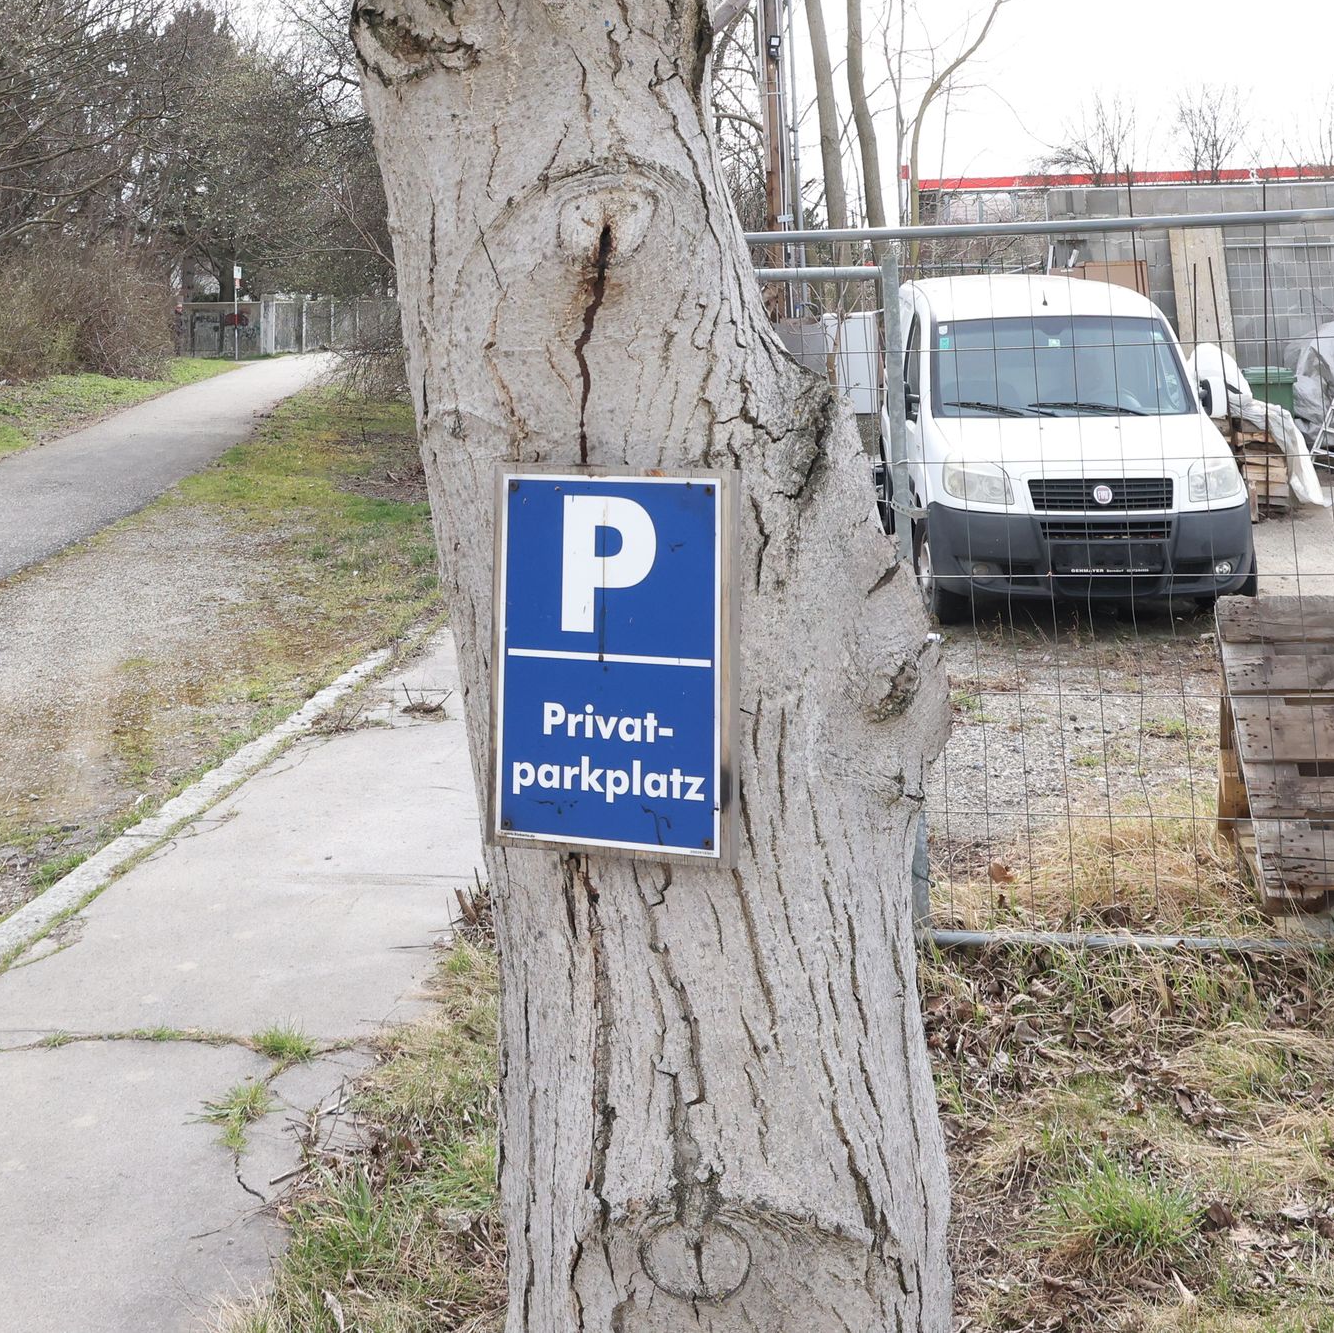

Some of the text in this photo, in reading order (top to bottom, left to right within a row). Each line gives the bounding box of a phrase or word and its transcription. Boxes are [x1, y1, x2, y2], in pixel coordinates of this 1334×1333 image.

[561, 494, 657, 633] P
[543, 701, 674, 743] Privat-
[512, 755, 706, 804] parkplatz
